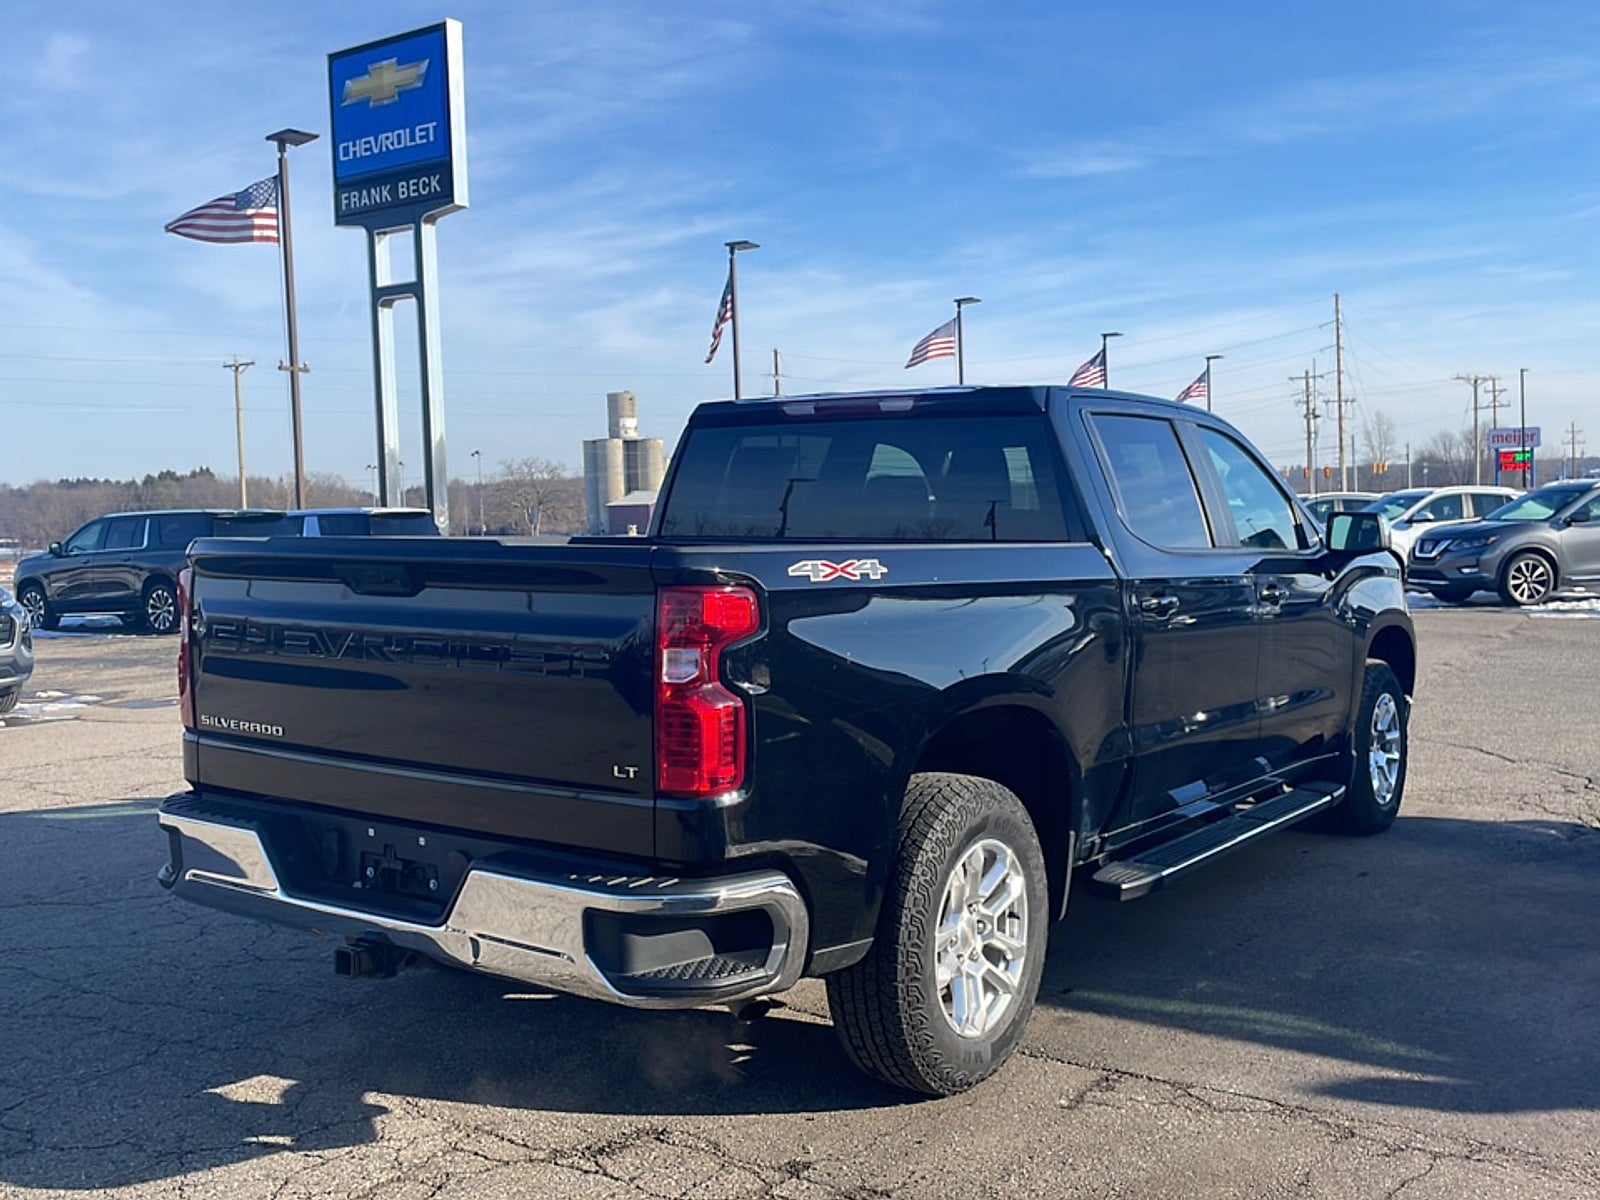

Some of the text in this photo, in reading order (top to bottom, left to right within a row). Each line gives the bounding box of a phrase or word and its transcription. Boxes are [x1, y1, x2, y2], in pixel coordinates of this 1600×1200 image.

[339, 121, 437, 161] CHEVROLET
[341, 174, 441, 211] FRANK BECK
[201, 714, 283, 736] SILVERADO
[612, 764, 639, 779] LT
